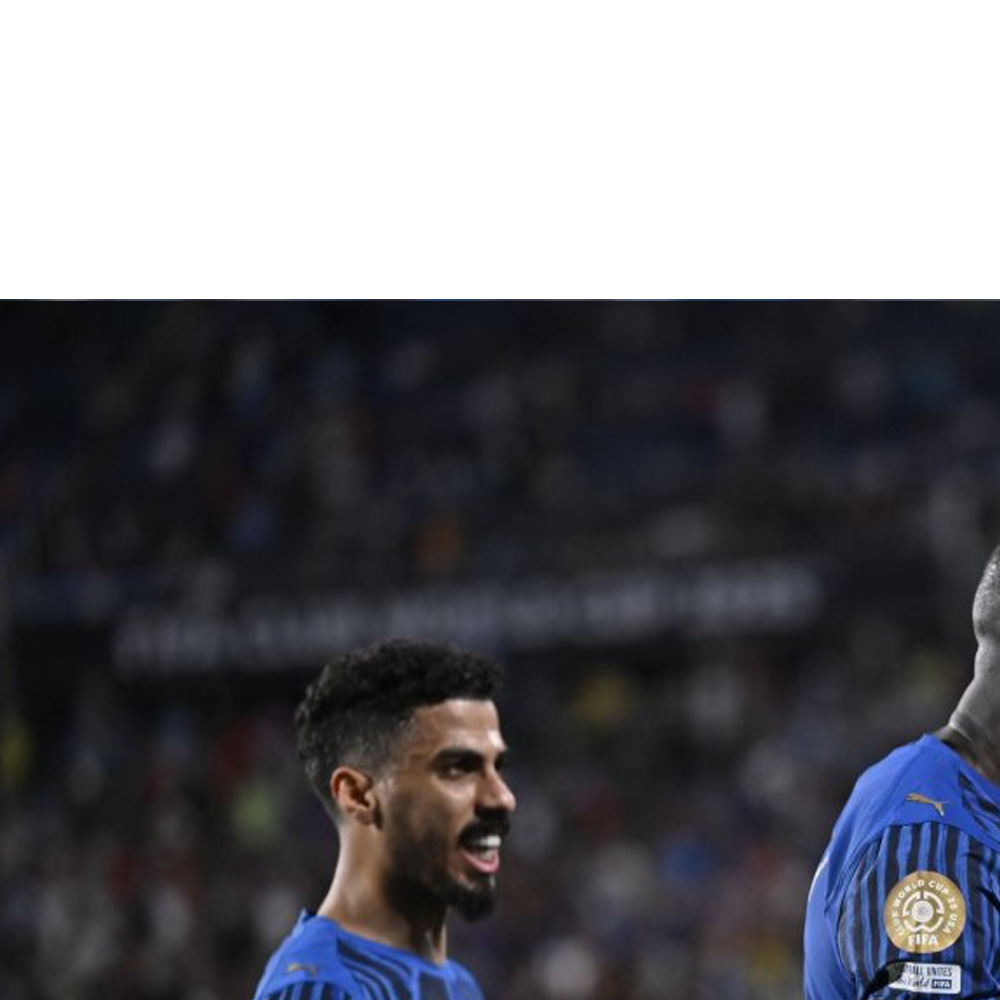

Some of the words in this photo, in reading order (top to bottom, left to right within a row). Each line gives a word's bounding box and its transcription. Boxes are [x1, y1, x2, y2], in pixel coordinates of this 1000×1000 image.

[893, 879, 925, 908] WORLD
[928, 880, 949, 895] CUP
[942, 913, 959, 935] USA
[908, 934, 939, 947] FIFA
